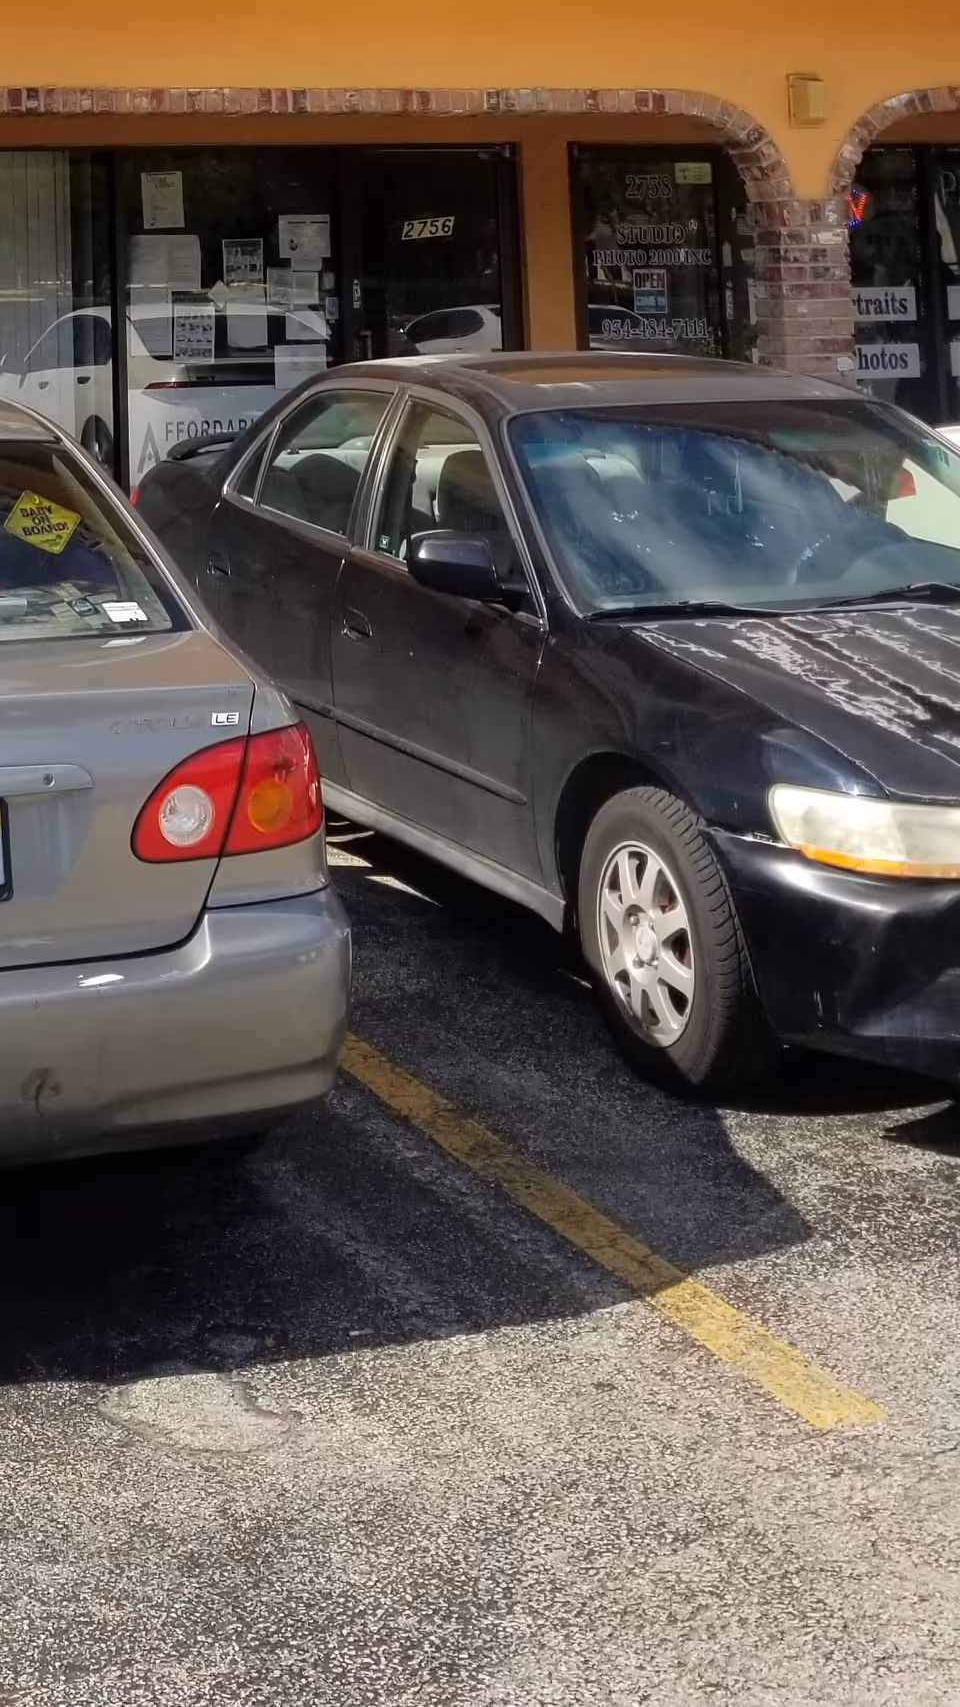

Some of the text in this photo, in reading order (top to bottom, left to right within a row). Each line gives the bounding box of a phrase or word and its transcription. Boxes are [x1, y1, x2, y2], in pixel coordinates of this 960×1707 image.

[624, 174, 673, 199] 2758
[402, 217, 453, 239] 2756
[616, 224, 686, 245] STUDIO
[592, 249, 647, 267] PHOTO
[648, 249, 681, 266] 2000
[634, 271, 666, 289] OPEN
[852, 291, 908, 316] traits
[602, 318, 709, 340] 954-484-7111
[855, 347, 908, 371] hotos
[165, 418, 255, 441] FFORDAB
[19, 505, 53, 518] BABY
[31, 515, 52, 526] ON
[21, 522, 69, 537] BOARD!
[214, 713, 238, 724] LE
